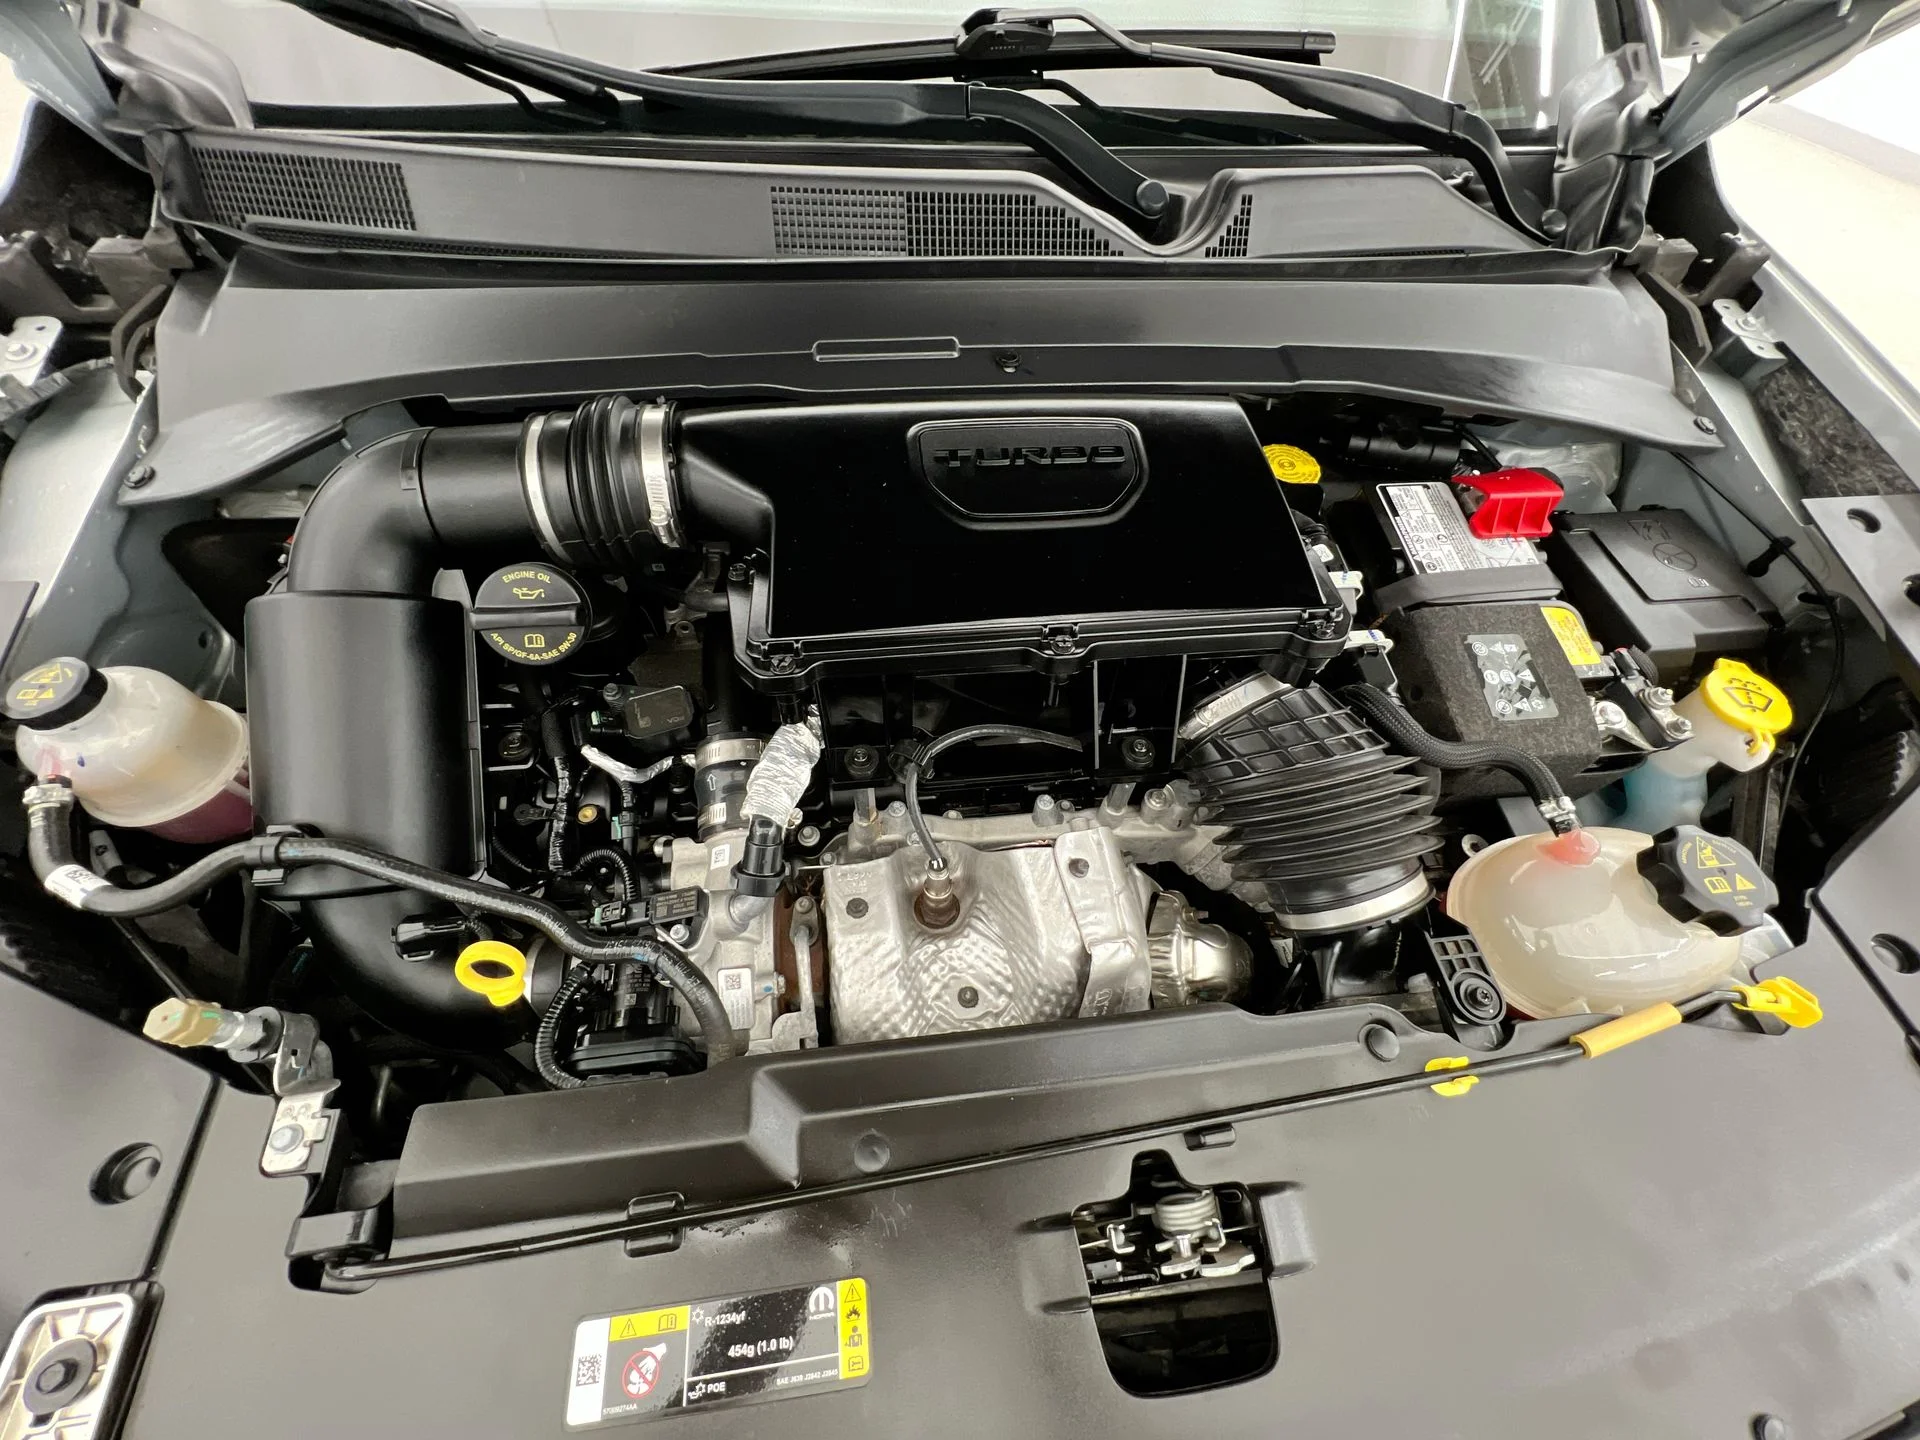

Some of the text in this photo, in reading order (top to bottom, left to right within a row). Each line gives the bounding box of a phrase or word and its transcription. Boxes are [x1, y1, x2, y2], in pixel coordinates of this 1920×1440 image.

[934, 446, 1125, 467] TURBO
[502, 571, 551, 584] ENGINE OIL
[490, 633, 502, 646] API
[558, 632, 578, 652] 5W-30
[704, 1311, 746, 1327] R-1234yf
[727, 1336, 793, 1358] 454g (1.0 lb)
[707, 1382, 726, 1393] POE
